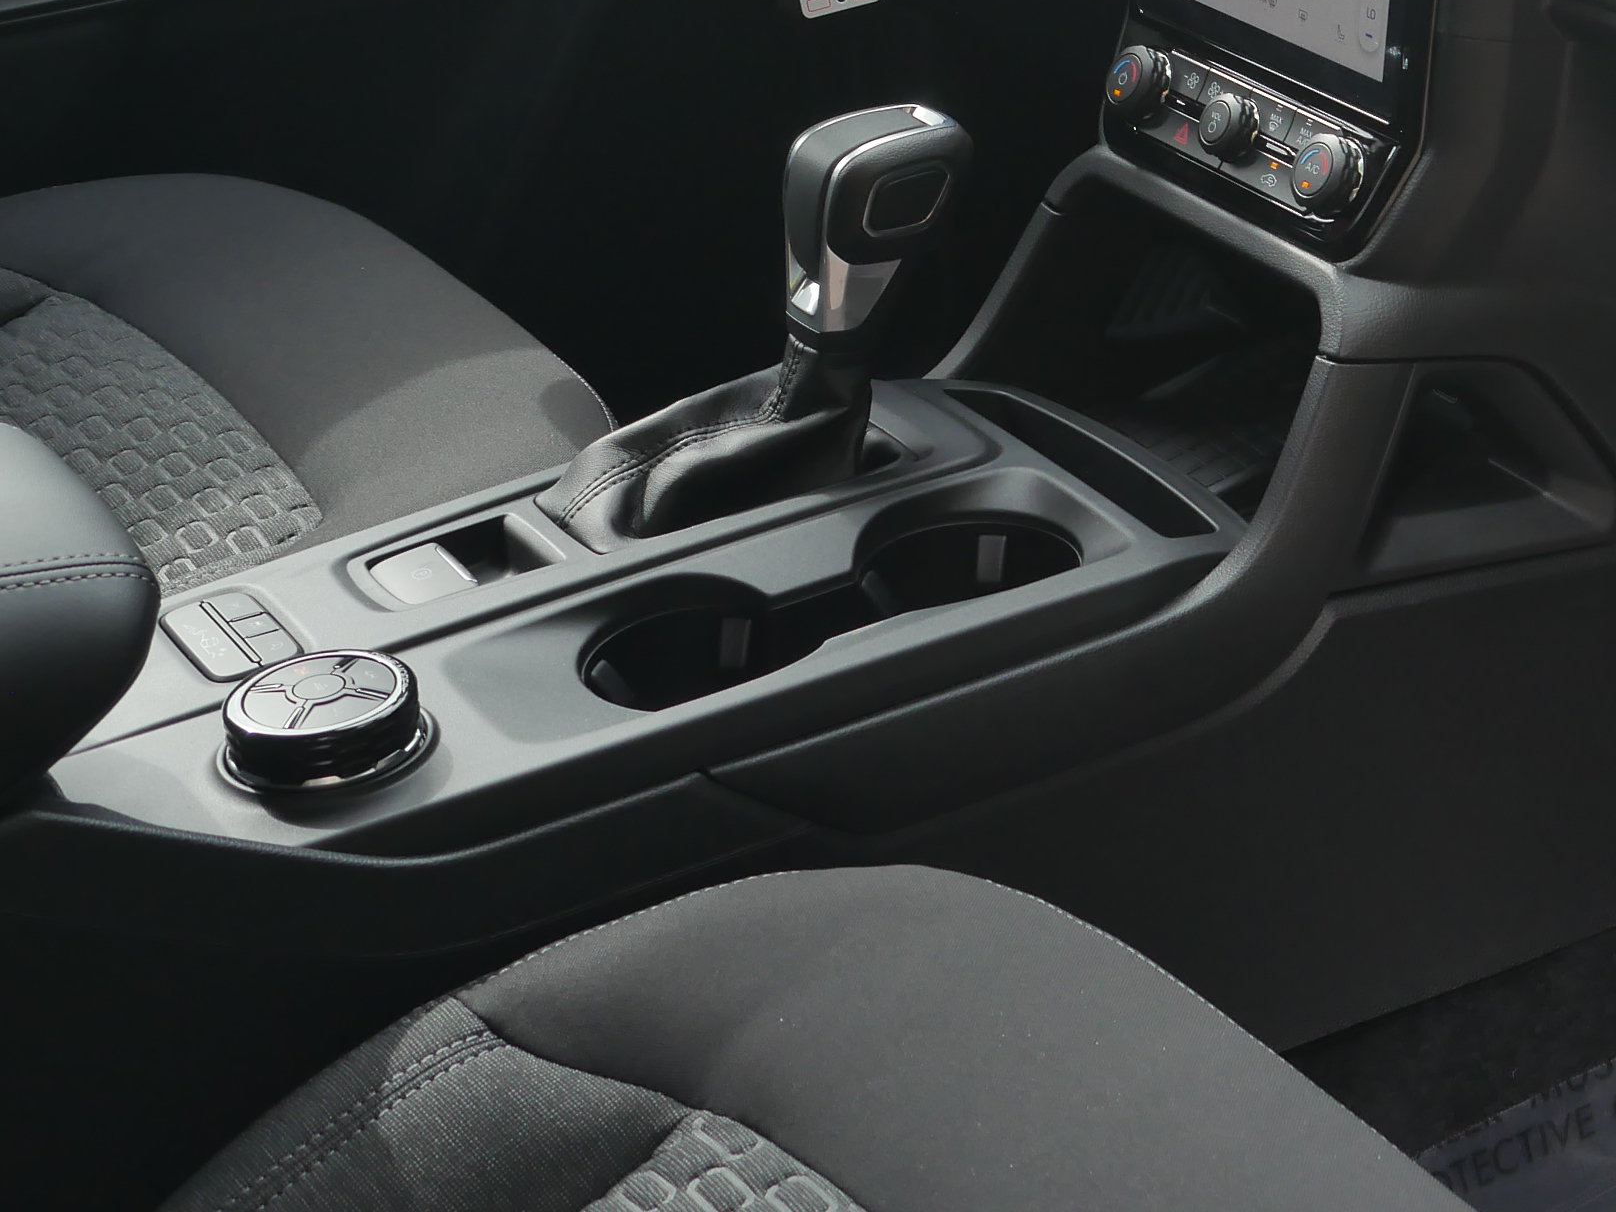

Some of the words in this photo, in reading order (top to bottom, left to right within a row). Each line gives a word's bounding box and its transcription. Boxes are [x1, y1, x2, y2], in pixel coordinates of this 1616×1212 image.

[1366, 7, 1377, 21] LO
[1211, 111, 1222, 123] VOL
[1270, 113, 1283, 125] MAX
[1300, 128, 1313, 139] MAX
[1305, 162, 1320, 175] A/C
